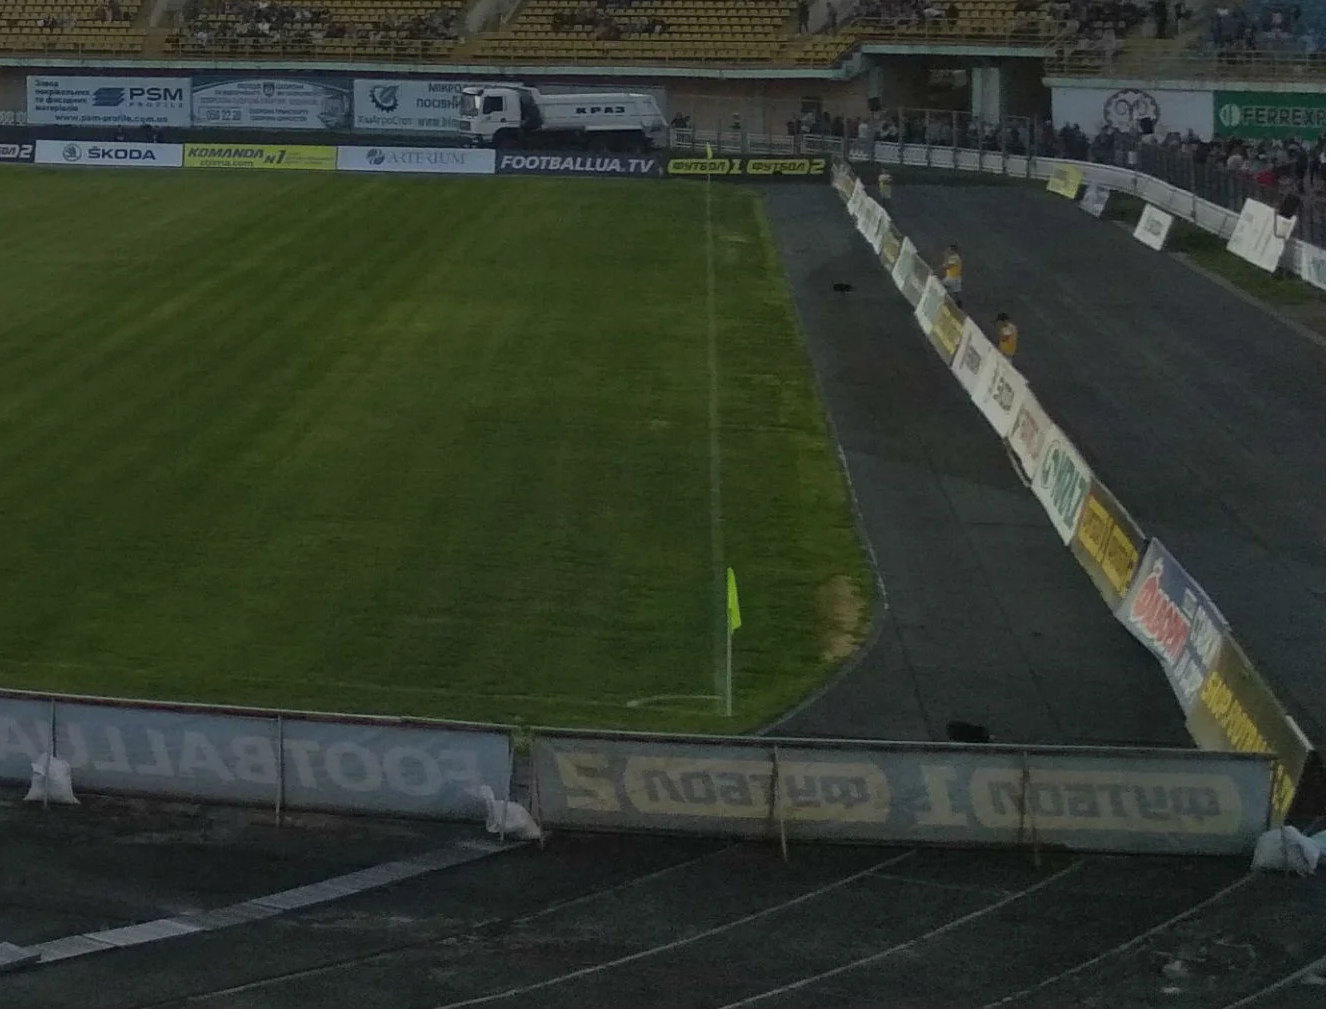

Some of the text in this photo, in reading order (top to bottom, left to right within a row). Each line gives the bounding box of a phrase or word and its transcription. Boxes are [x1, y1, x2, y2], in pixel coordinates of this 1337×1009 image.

[129, 88, 183, 102] PSM
[575, 107, 626, 115] КРАЗ
[18, 144, 35, 159] 2
[88, 145, 156, 161] ŠKODA
[188, 148, 264, 159] KOMANDA
[387, 151, 466, 165] ARTERIUM
[500, 155, 655, 173] FOOTBALLUA.TV
[672, 159, 743, 174] ФУТБОЛ 1
[751, 159, 826, 175] ФУТБОЛ 2
